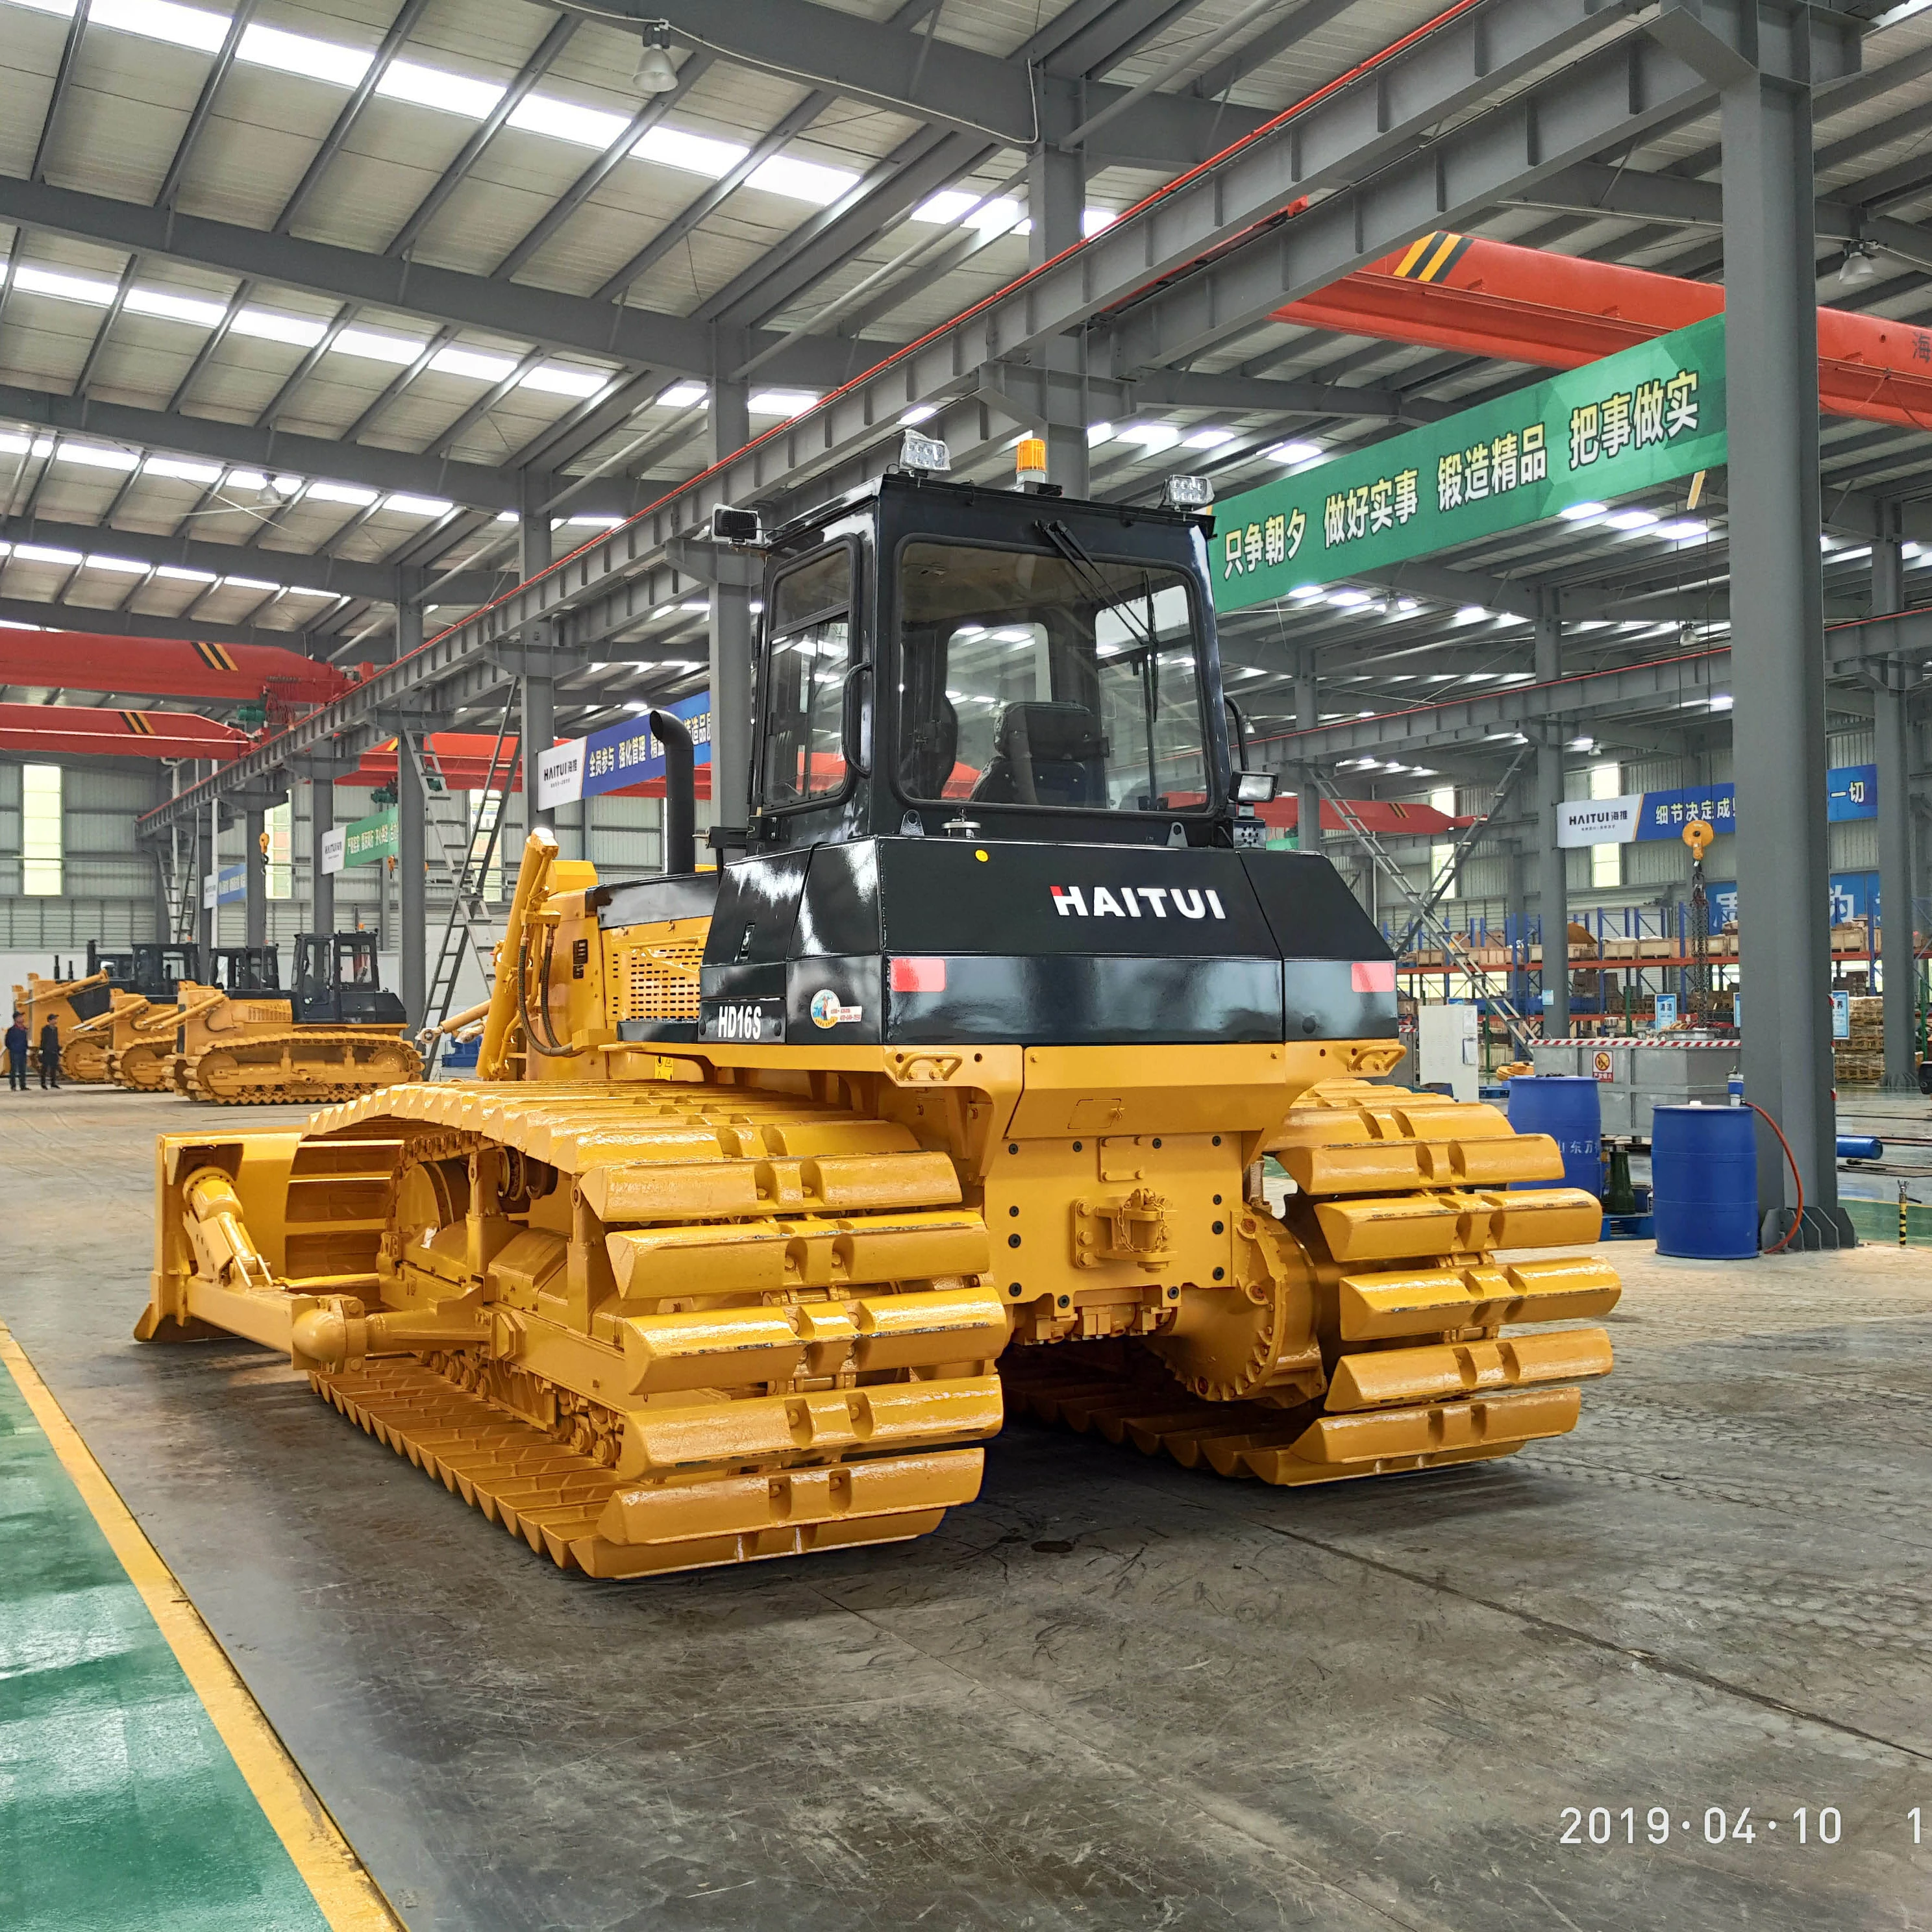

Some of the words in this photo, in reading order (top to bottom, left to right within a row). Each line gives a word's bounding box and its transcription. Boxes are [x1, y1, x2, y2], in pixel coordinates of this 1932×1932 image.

[1224, 508, 1306, 580] 只争朝夕
[1324, 469, 1418, 549] 做好实事
[1437, 423, 1546, 511] 锻造精品
[1570, 369, 1699, 469] 把事做实
[544, 762, 567, 781] HAITUI
[589, 746, 614, 778] 全员参与
[619, 735, 646, 769] 强化管理
[1569, 812, 1609, 825] HAITUI
[1611, 810, 1628, 821] 海推
[1655, 797, 1735, 825] 细节决定成
[1831, 782, 1864, 803] 一切
[1050, 886, 1226, 919] HAITUI
[718, 1006, 762, 1040] HD16S
